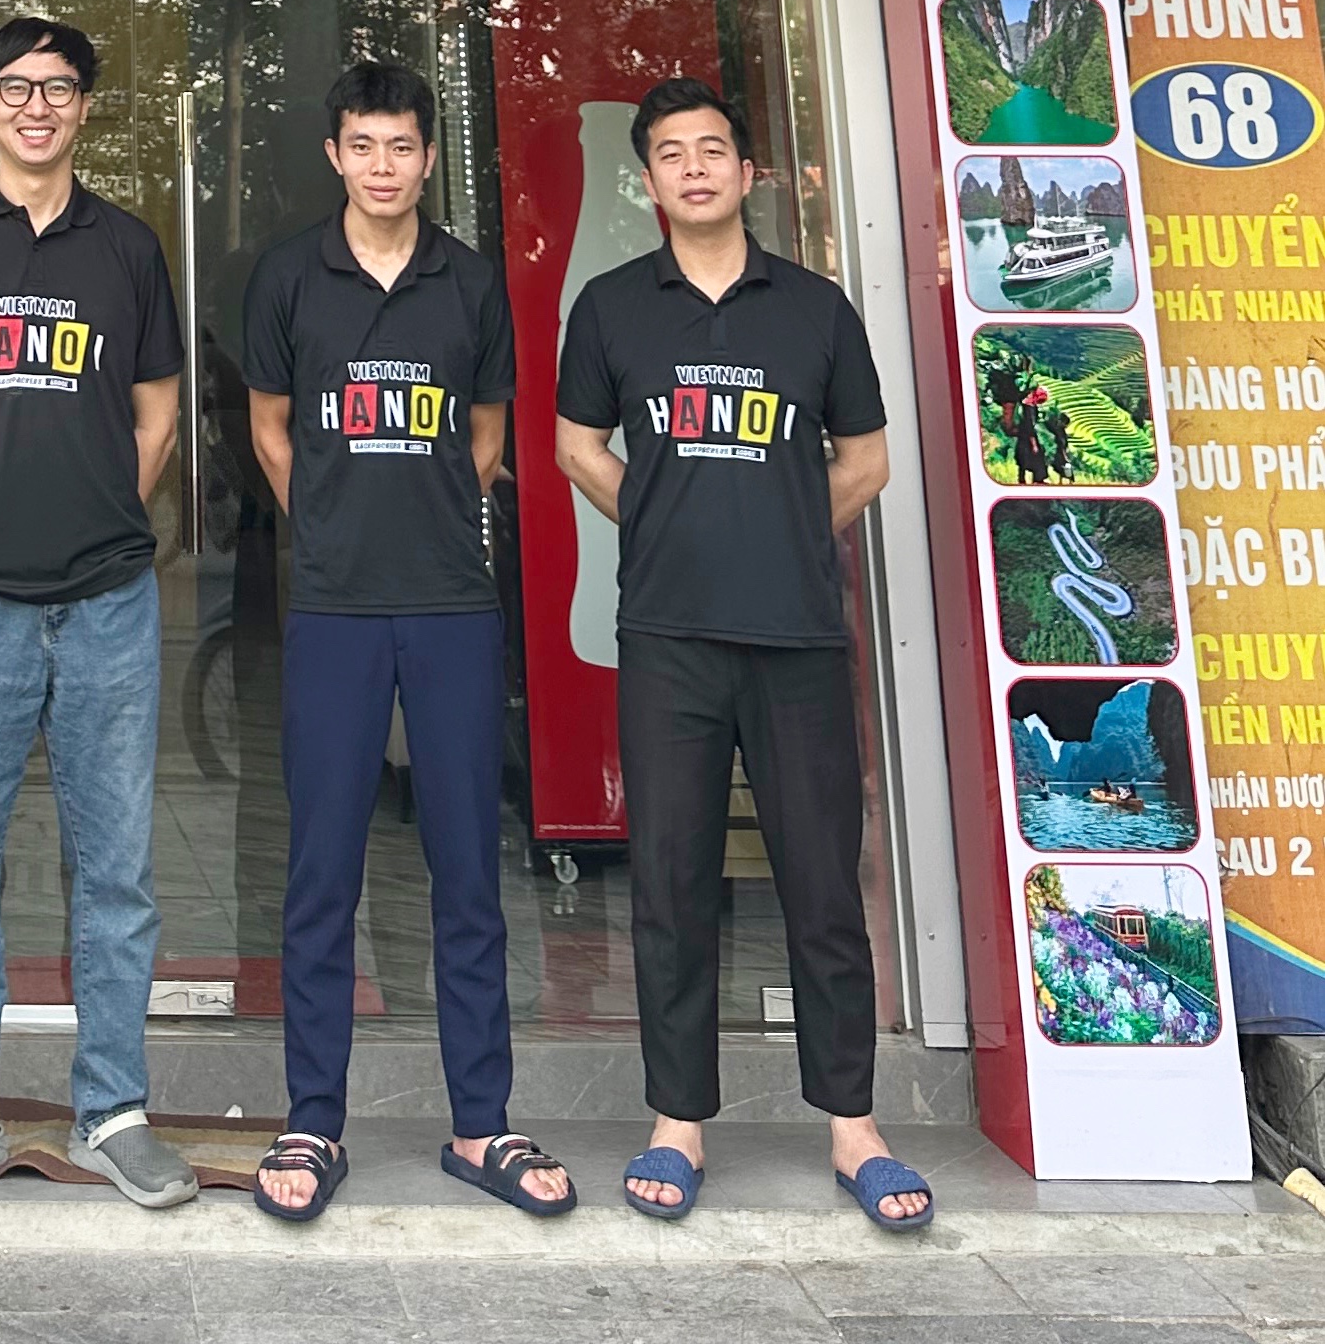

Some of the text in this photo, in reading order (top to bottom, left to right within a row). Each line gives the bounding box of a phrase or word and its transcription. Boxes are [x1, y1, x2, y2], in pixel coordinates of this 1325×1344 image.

[1166, 70, 1280, 161] 68
[1144, 193, 1325, 268] CHUYỂN
[1234, 290, 1325, 322] NHAN
[347, 360, 432, 384] VIETNAM
[675, 364, 764, 389] VIETNAM
[1162, 356, 1266, 410] HÀNG
[321, 384, 457, 438] HANOI
[645, 386, 797, 445] HANOI
[1170, 439, 1242, 491] BƯU
[1192, 632, 1325, 681] CHUY
[1274, 773, 1325, 816] ĐƯỢ
[1288, 836, 1316, 877] 2
